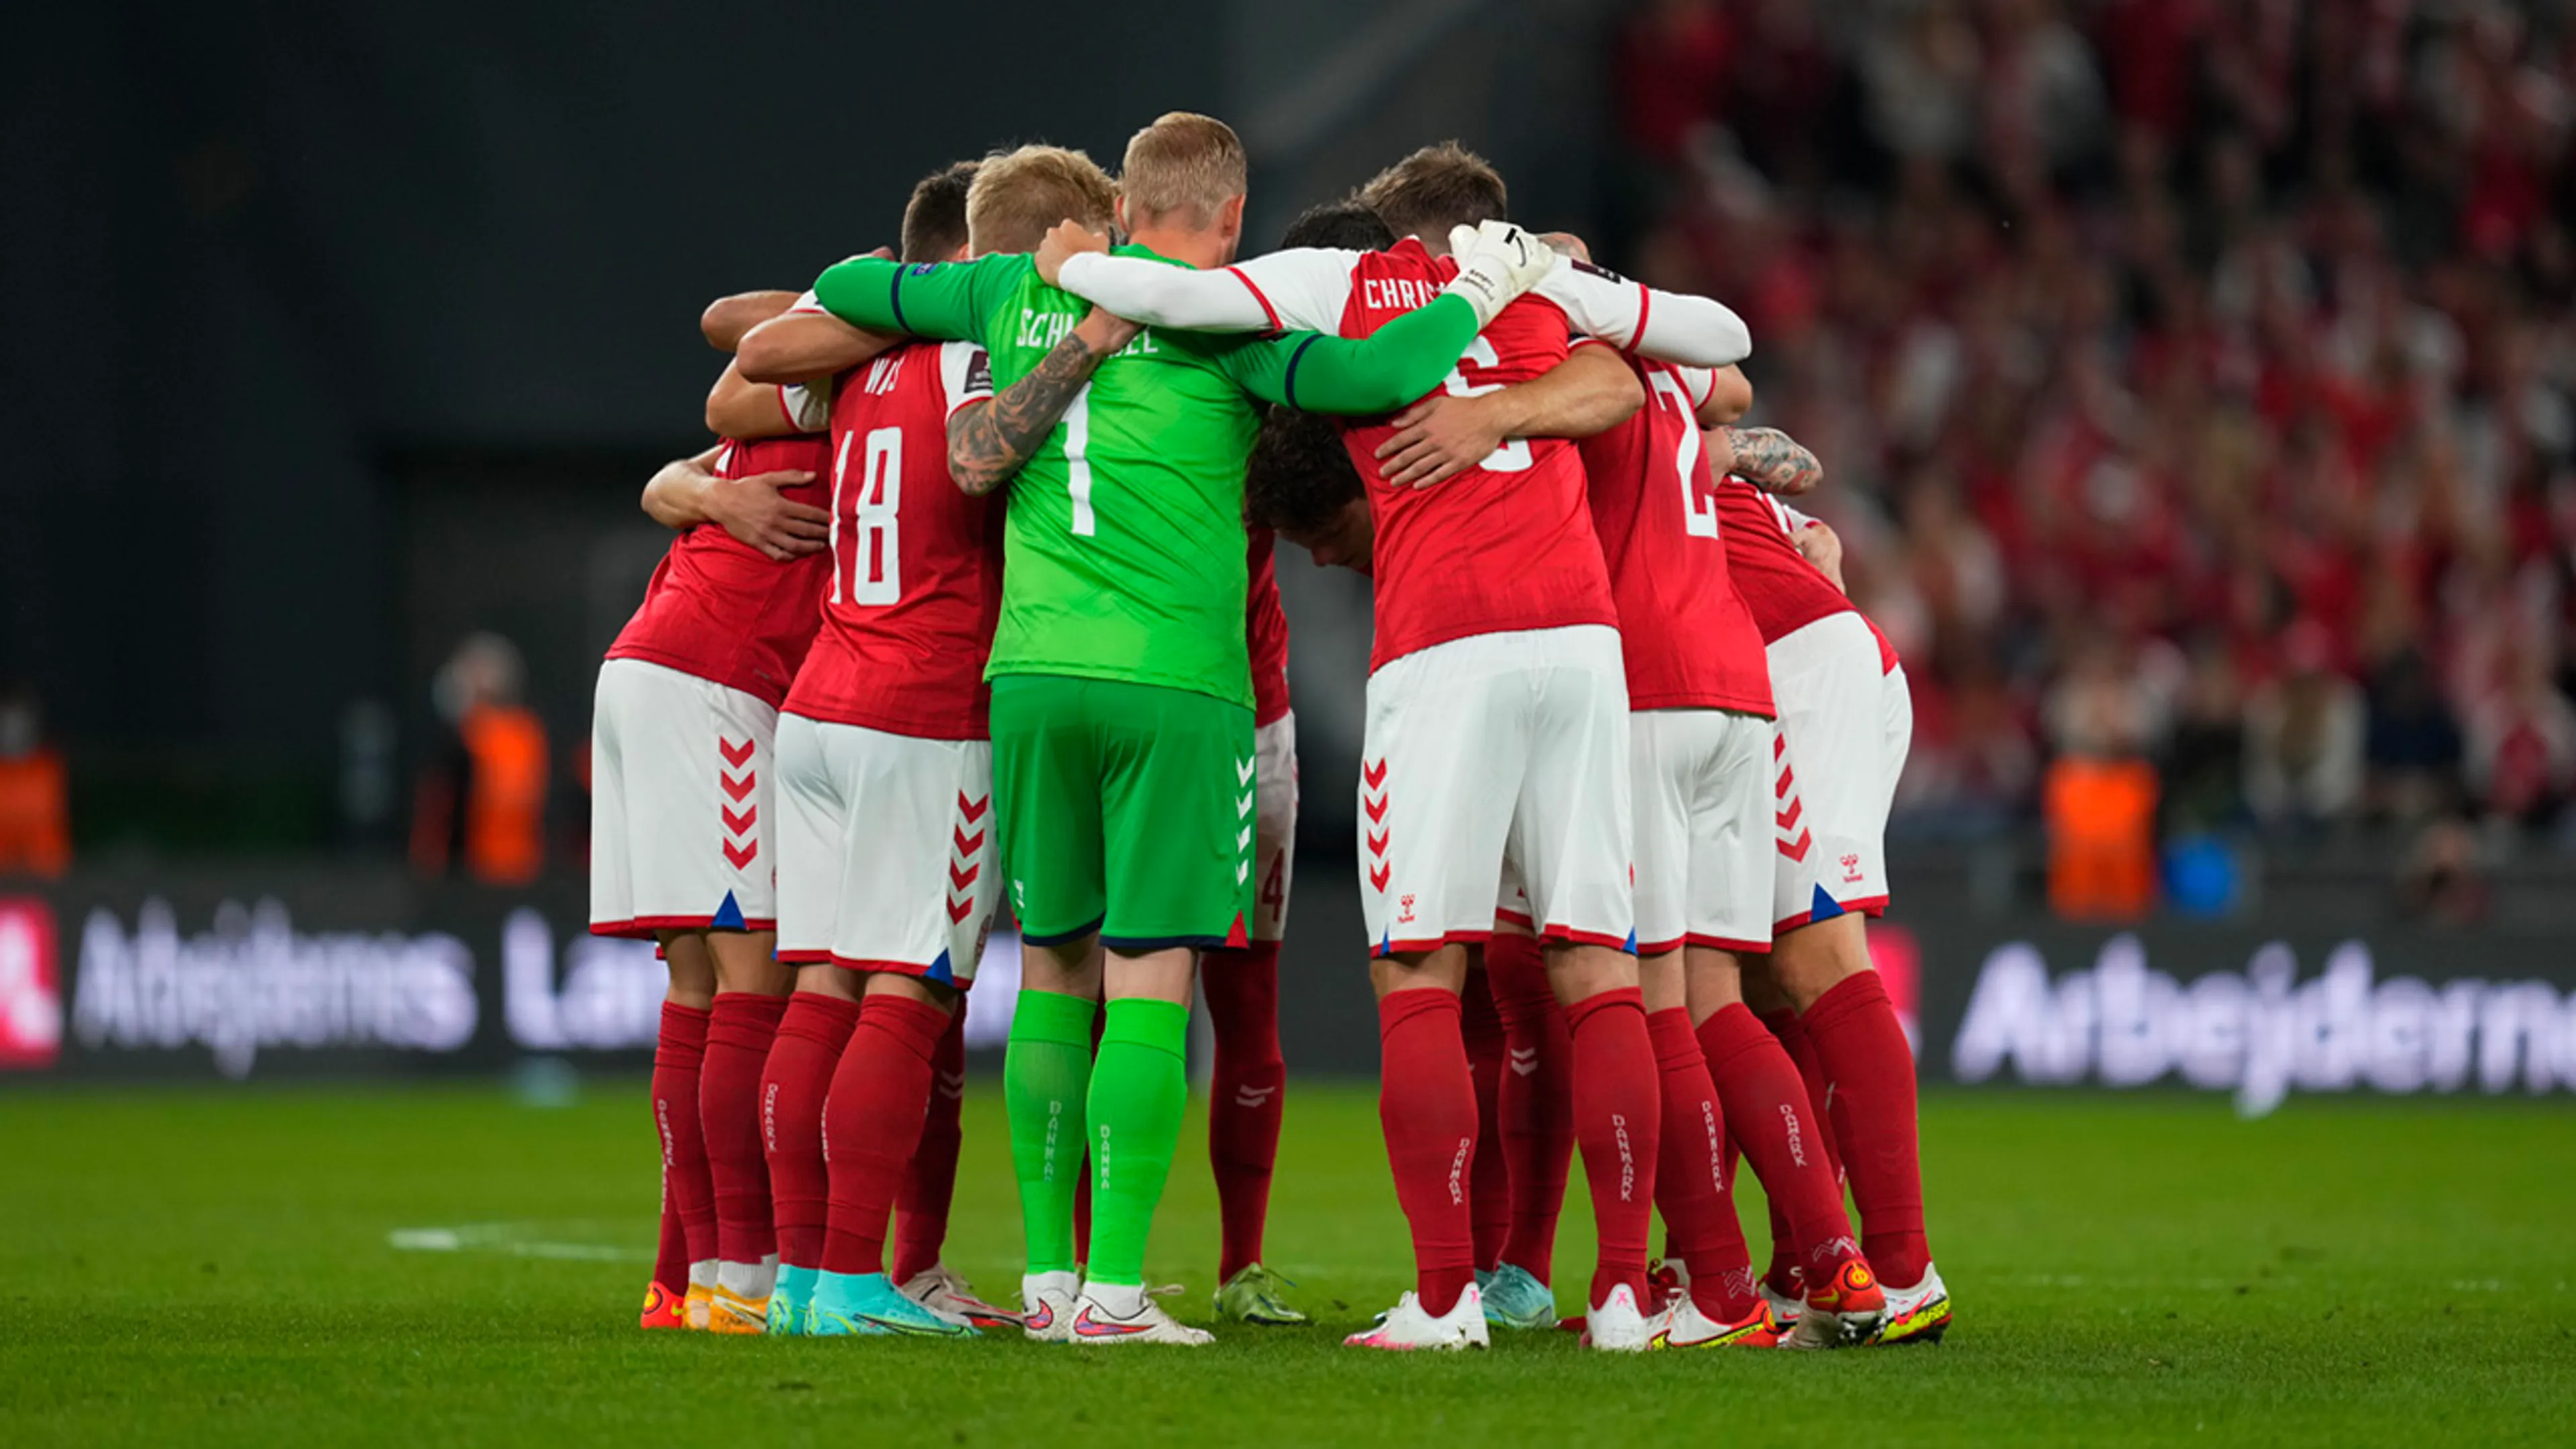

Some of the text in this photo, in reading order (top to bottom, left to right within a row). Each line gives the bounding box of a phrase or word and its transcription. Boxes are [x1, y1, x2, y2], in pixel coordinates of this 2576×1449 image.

[829, 427, 902, 605] 18
[1061, 380, 1095, 536] 1
[1648, 370, 1719, 539] 2
[1612, 1114, 1633, 1201] DANMARK
